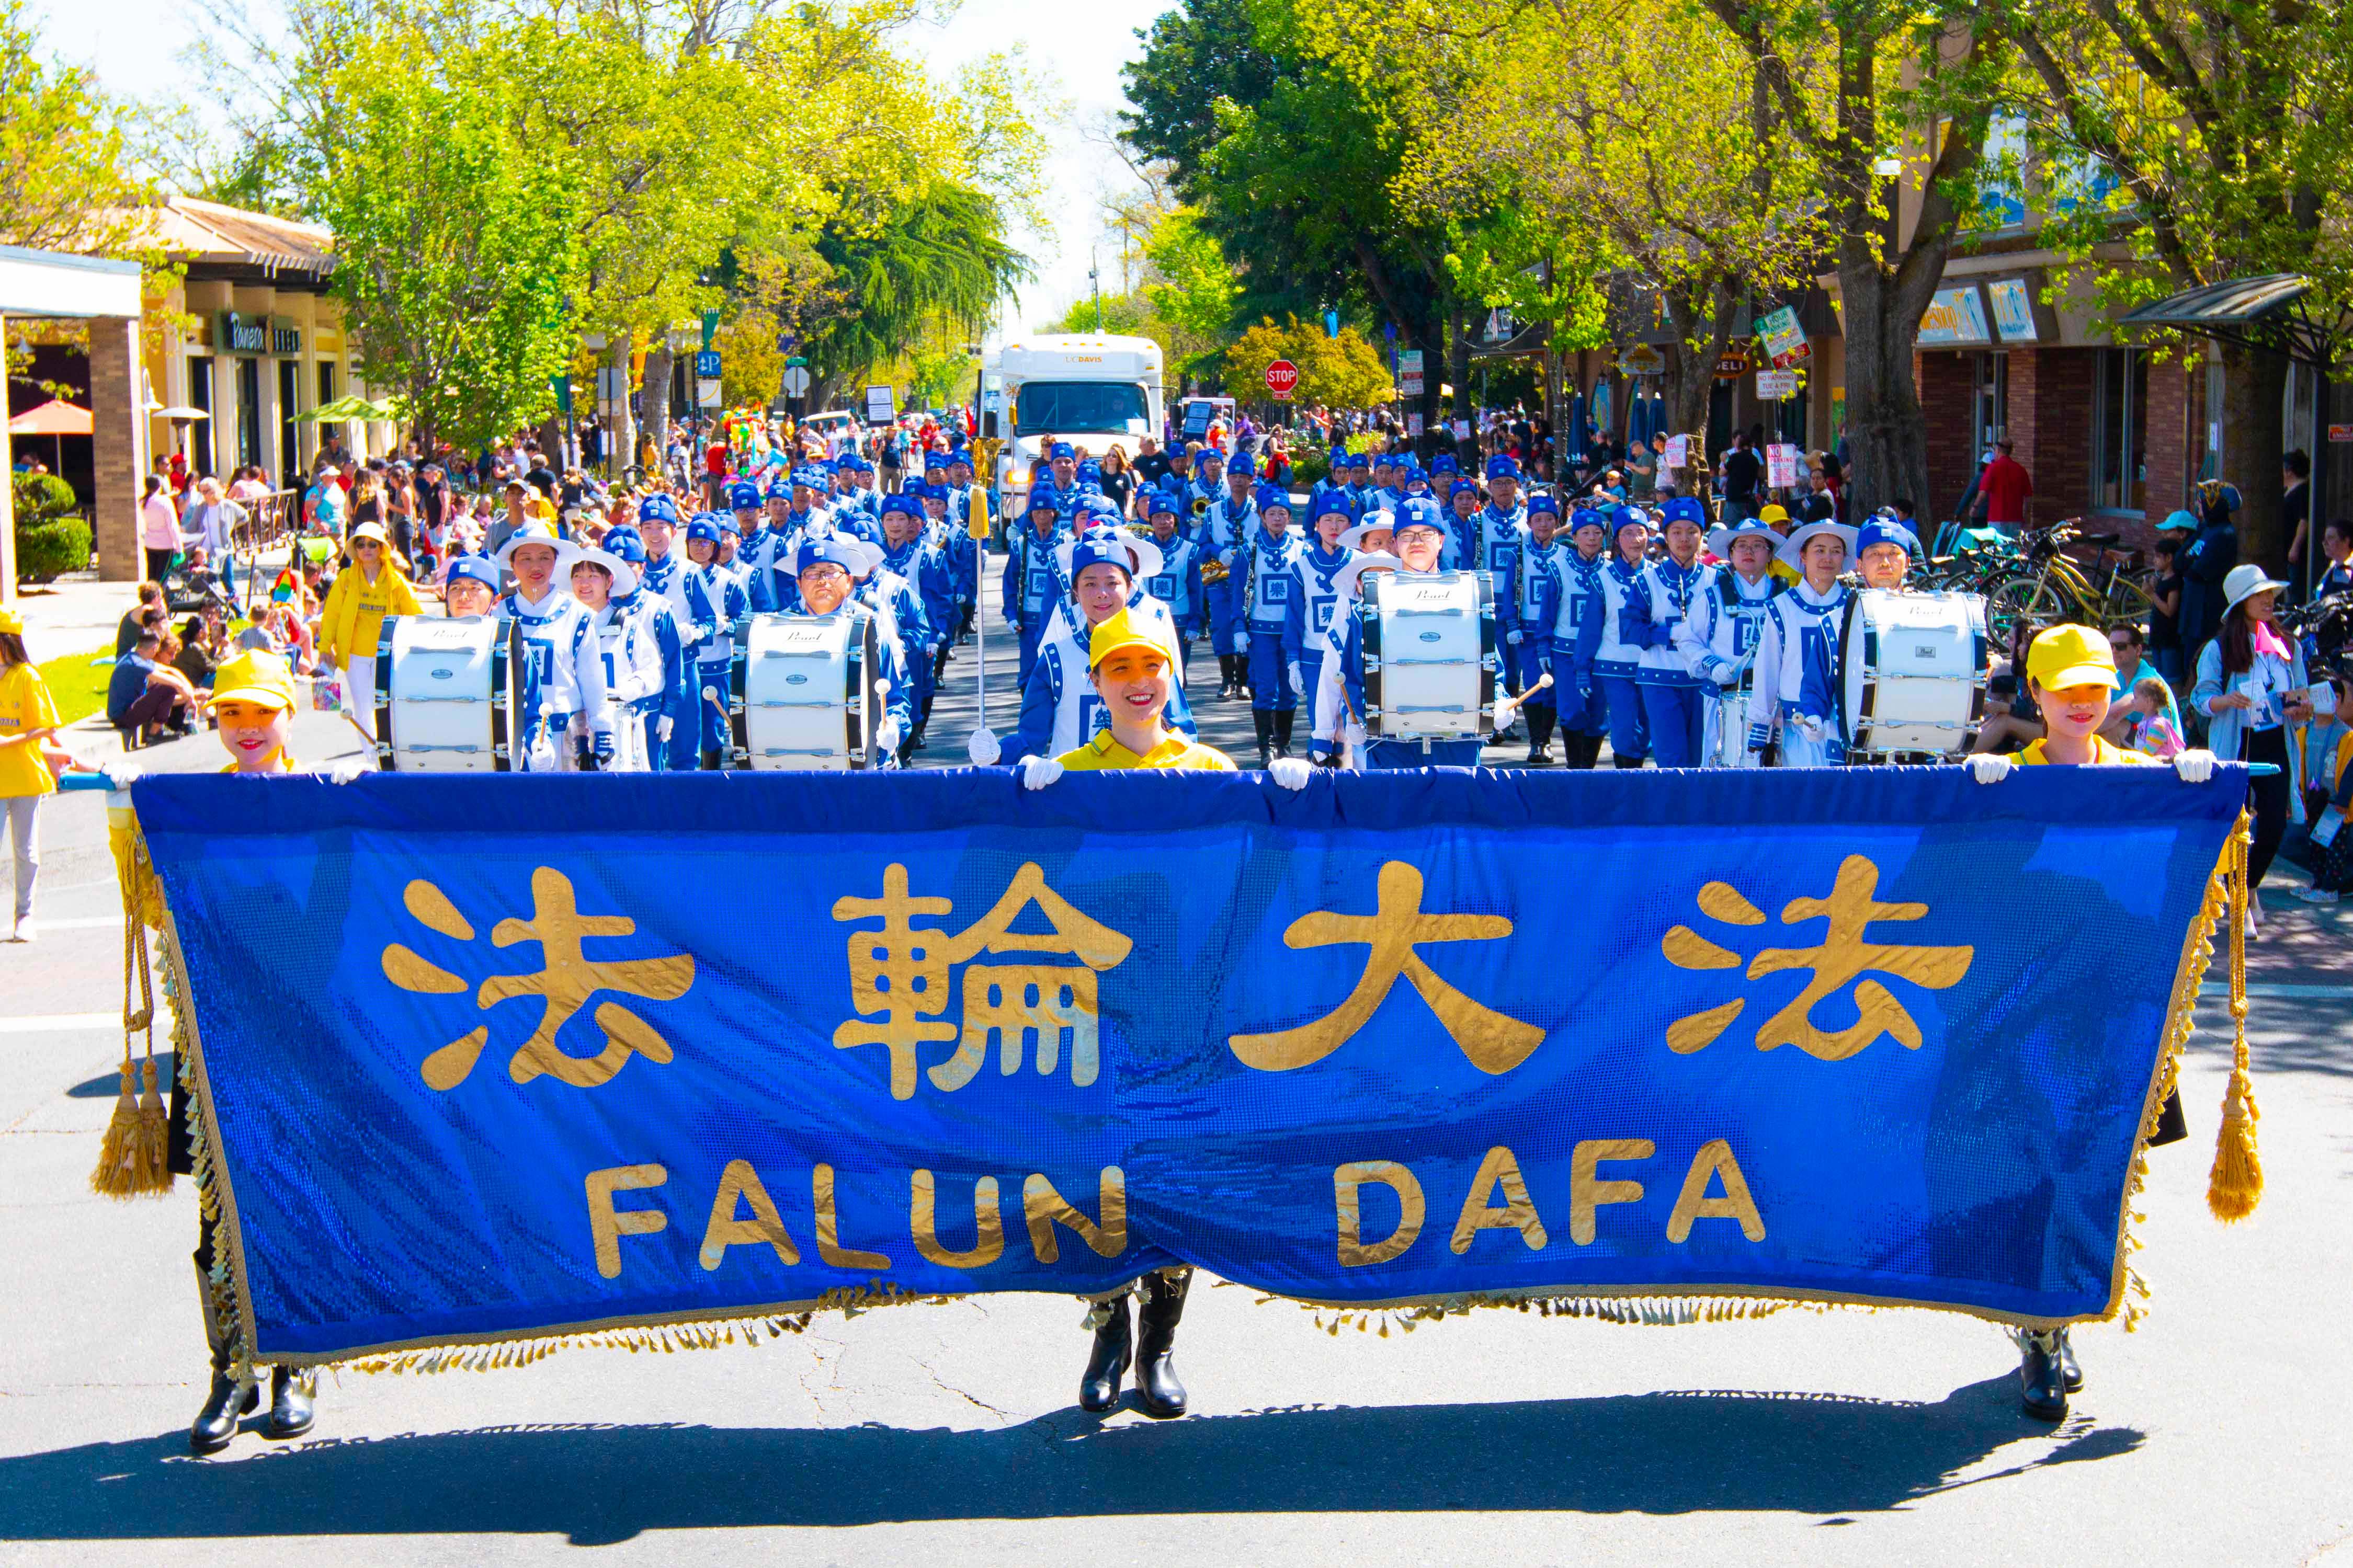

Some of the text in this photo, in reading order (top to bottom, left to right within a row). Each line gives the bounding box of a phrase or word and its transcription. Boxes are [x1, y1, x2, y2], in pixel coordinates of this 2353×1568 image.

[1768, 310, 1789, 324] HOUR
[231, 312, 264, 350] Panera
[708, 356, 720, 372] P
[1268, 370, 1295, 382] STOP
[1769, 446, 1780, 456] NO
[1269, 582, 1286, 598] 樂
[1416, 590, 1451, 600] Pearl
[788, 631, 823, 640] Pearl
[382, 854, 1974, 1101] 法輪大法
[585, 1138, 1767, 1278] FALUN DAFA
